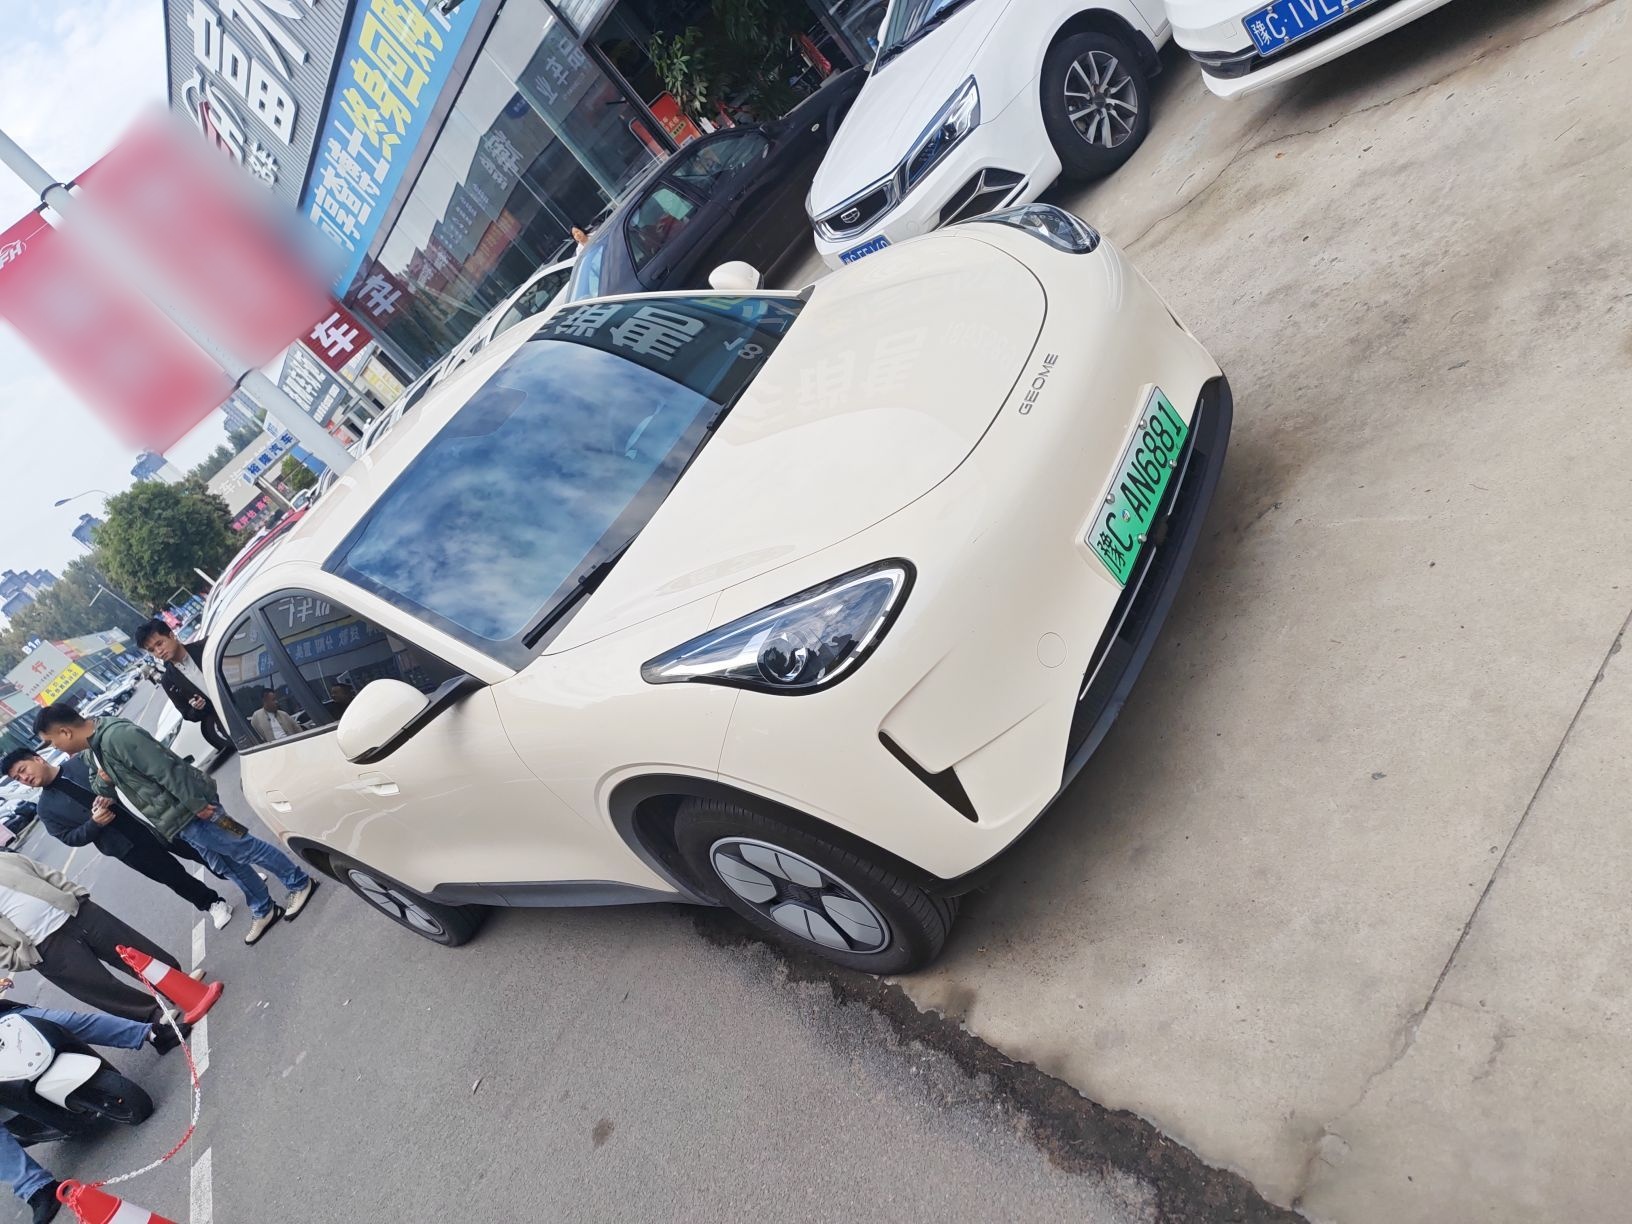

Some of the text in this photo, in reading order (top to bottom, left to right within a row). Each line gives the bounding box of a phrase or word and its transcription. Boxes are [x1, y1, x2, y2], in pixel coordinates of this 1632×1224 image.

[310, 0, 459, 252] 可享查博士终身回购
[310, 312, 359, 358] 车
[1018, 353, 1059, 416] GEOME
